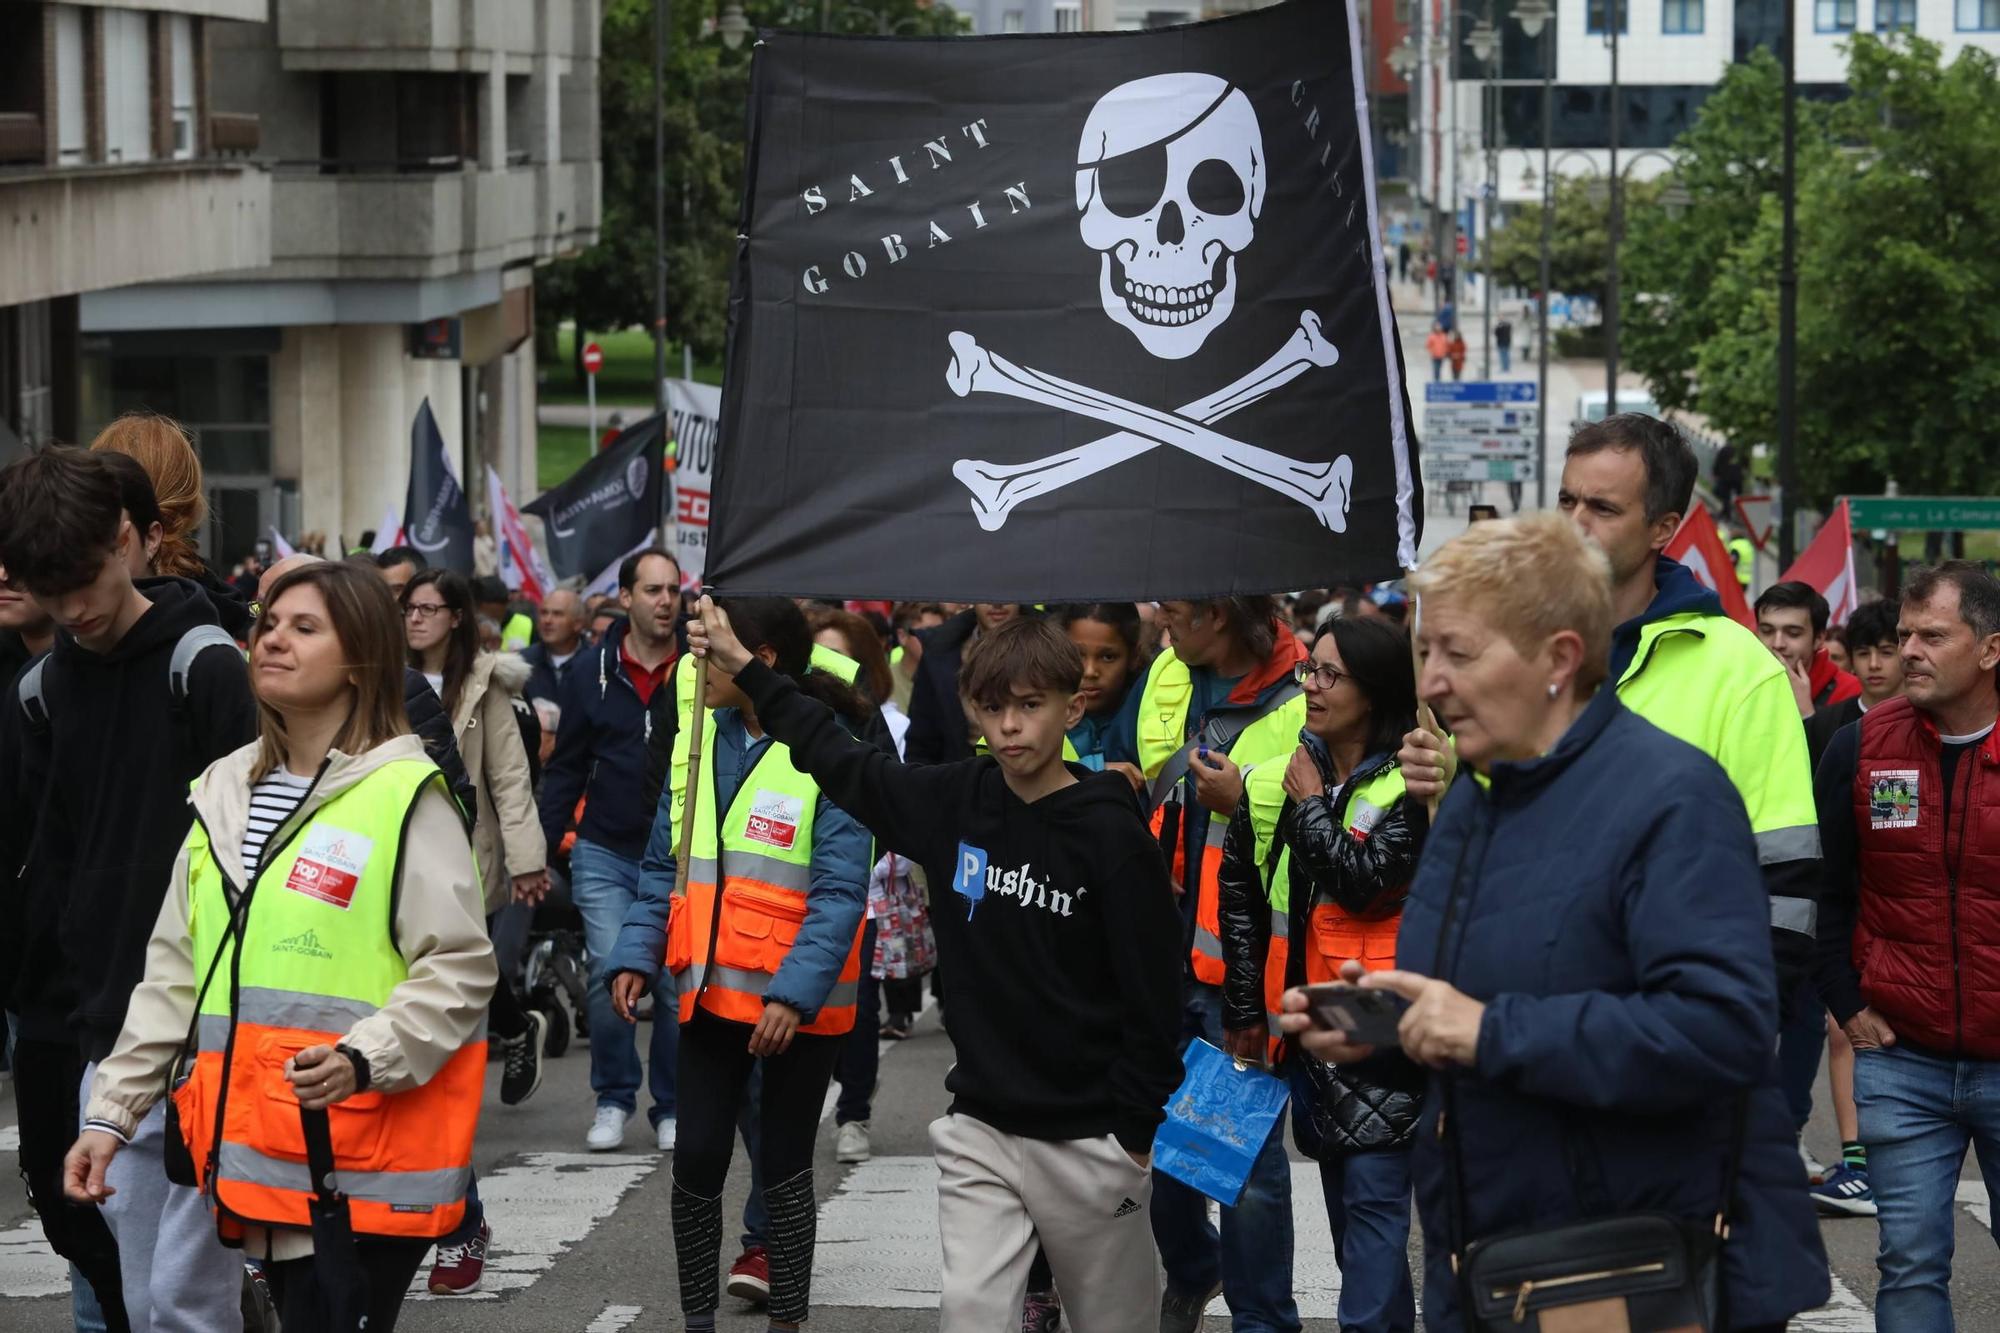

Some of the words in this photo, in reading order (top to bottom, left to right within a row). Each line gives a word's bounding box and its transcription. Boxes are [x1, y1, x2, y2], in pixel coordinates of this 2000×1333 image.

[803, 118, 990, 215] SAINT
[803, 181, 1032, 295] GOBAIN
[755, 807, 795, 823] SAINT-GOBAIN
[1871, 821, 1884, 830] POR
[1884, 821, 1892, 829] SU
[272, 944, 334, 960] SAINT-GOBAIN
[1114, 1202, 1142, 1218] adidas
